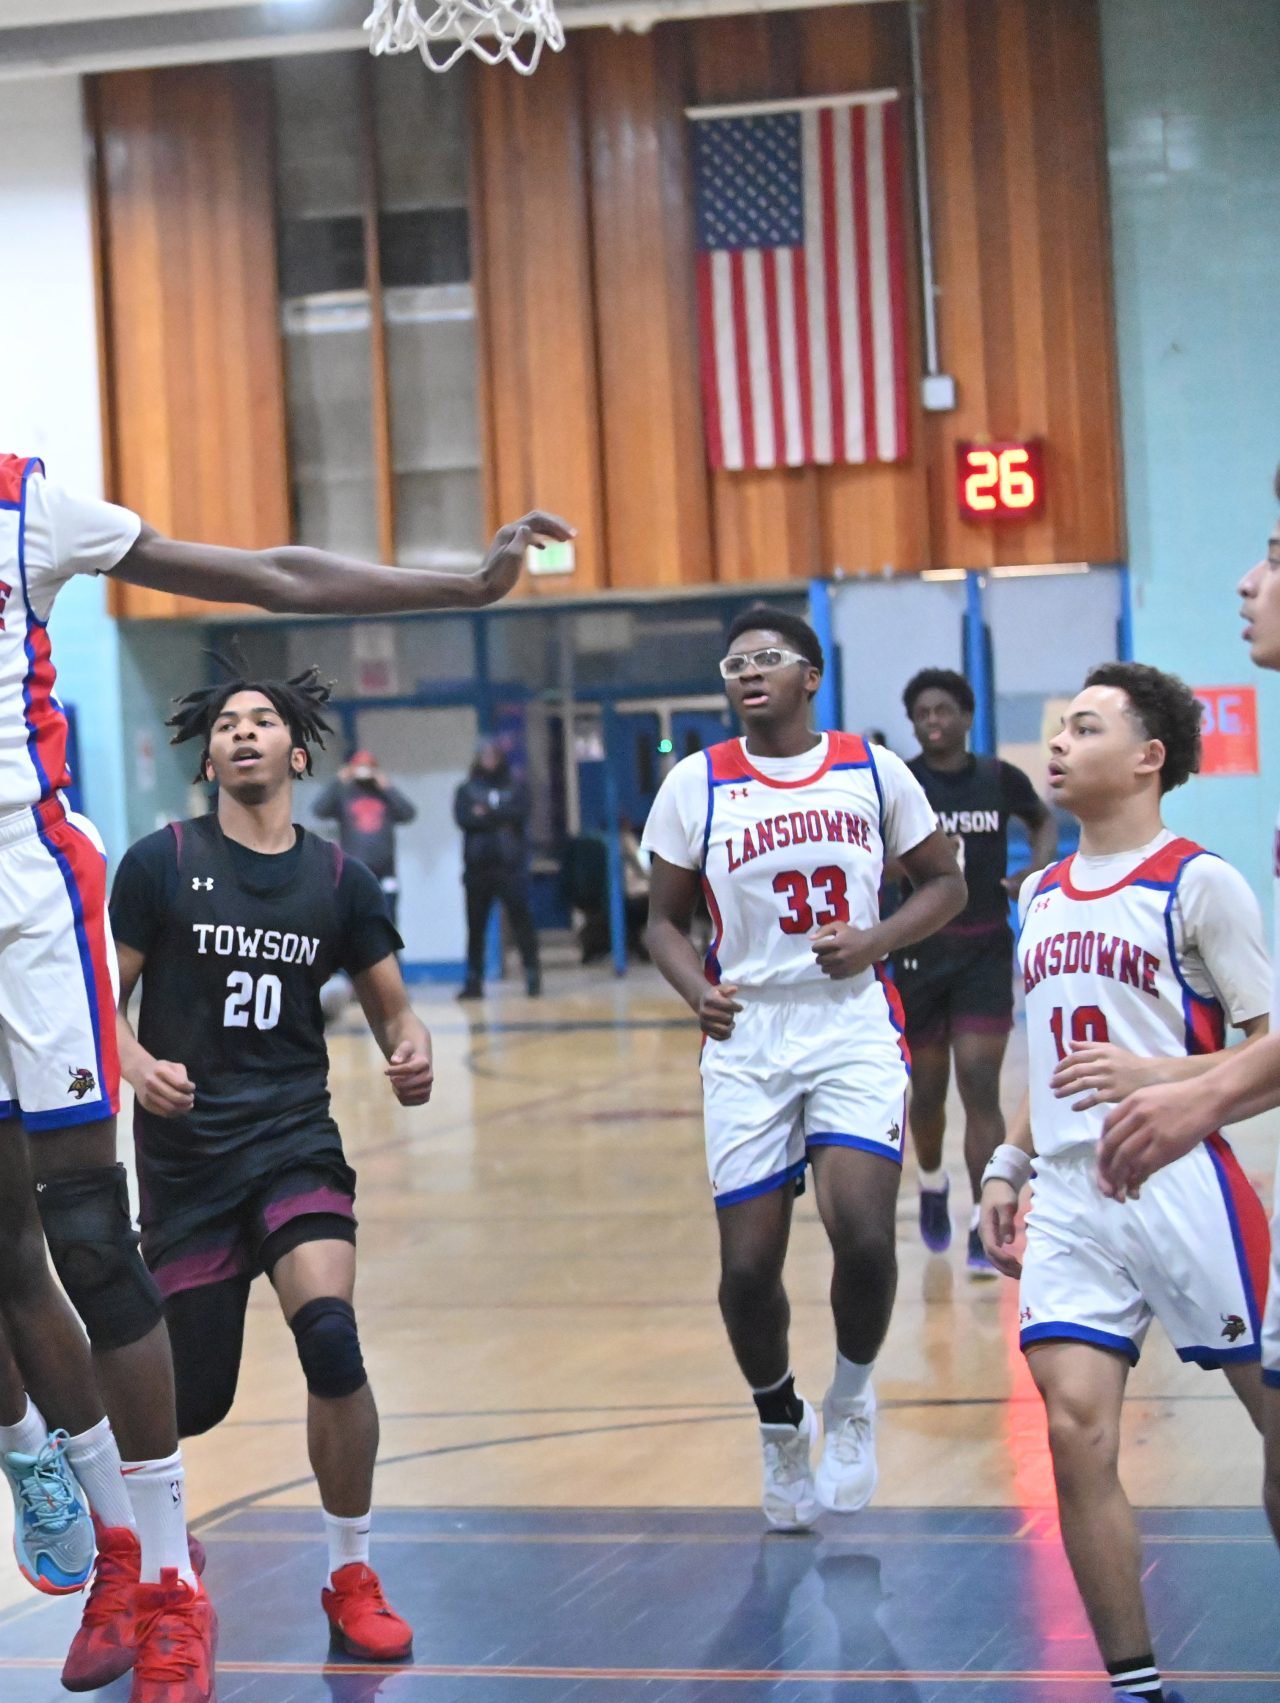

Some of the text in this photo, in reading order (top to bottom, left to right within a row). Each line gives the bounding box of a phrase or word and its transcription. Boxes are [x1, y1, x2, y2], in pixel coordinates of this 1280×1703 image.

[965, 448, 1034, 510] 26
[725, 810, 872, 873] LANSDOWNE
[772, 865, 851, 935] 33
[193, 924, 320, 966] TOWSON
[1023, 930, 1161, 998] ANSDOWNE
[223, 971, 283, 1031] 20
